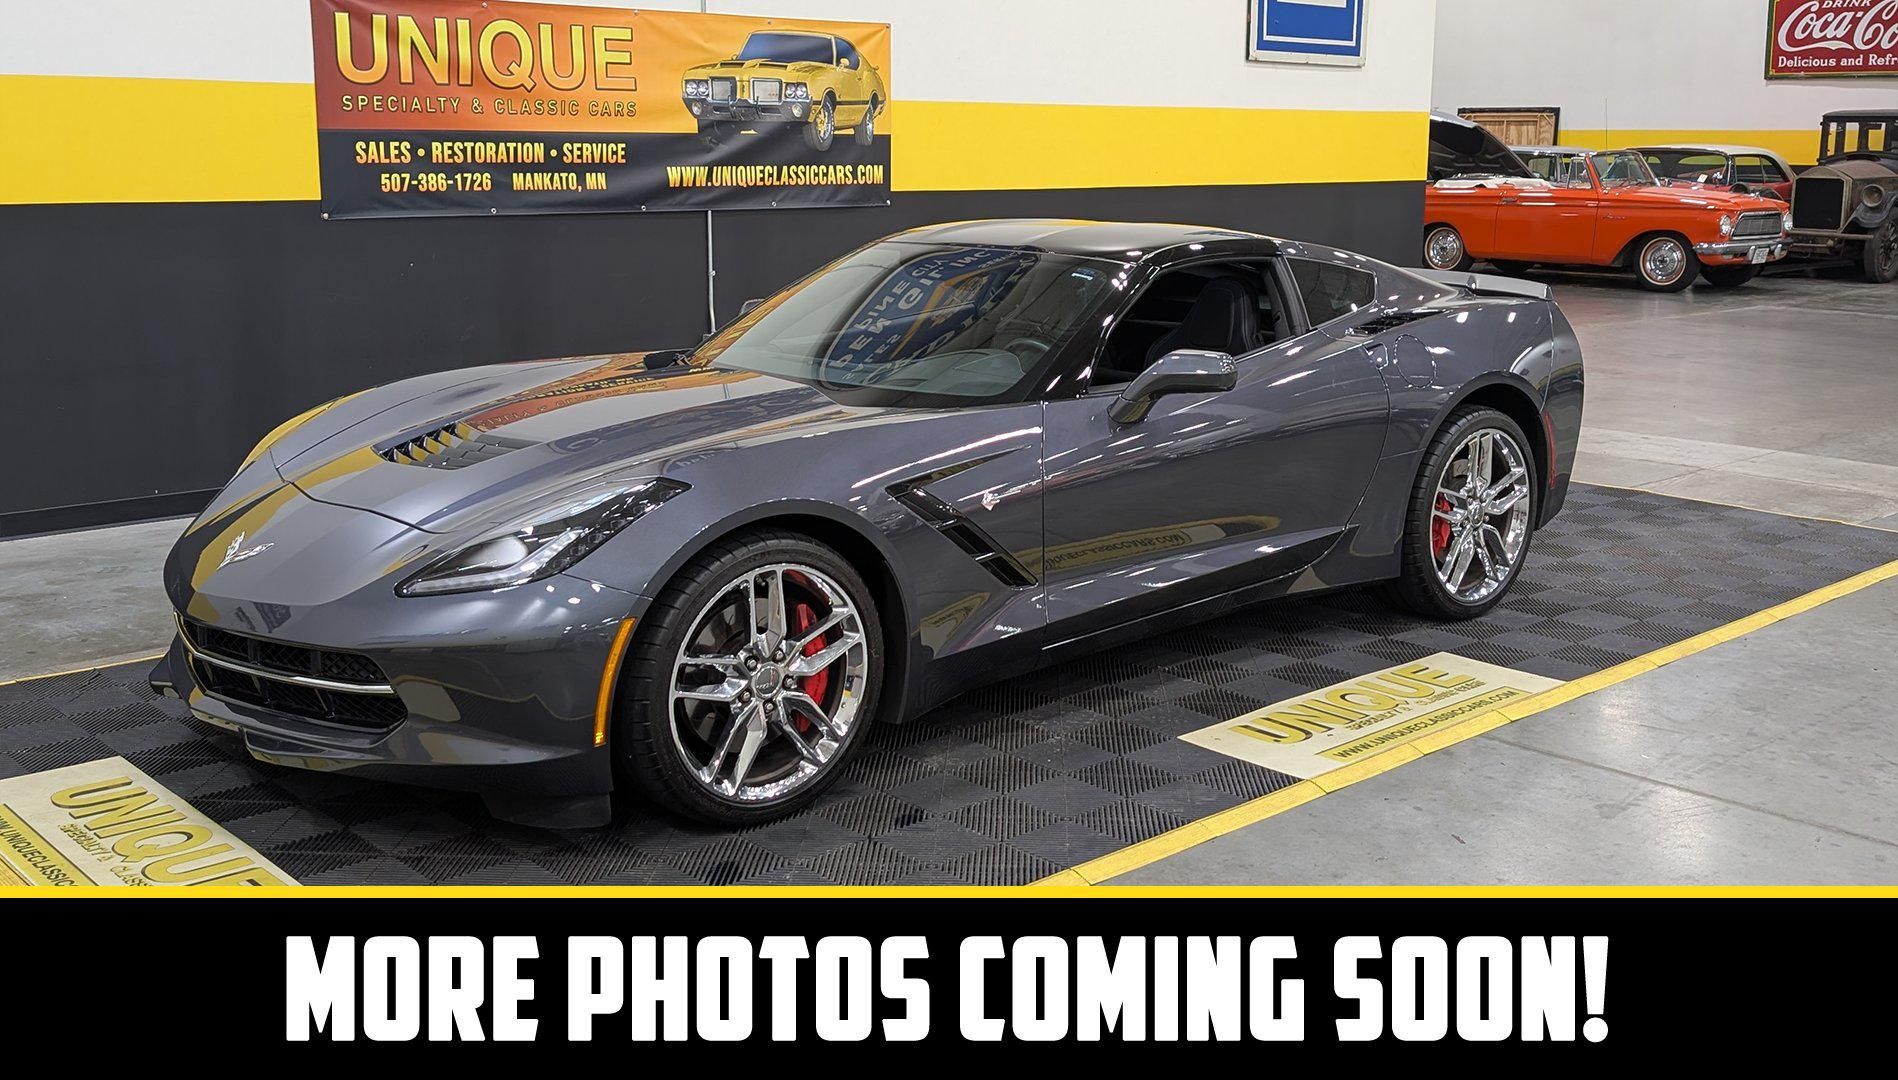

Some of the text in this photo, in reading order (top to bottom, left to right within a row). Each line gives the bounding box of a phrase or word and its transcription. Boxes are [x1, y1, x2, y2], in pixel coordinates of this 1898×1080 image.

[334, 11, 637, 93] UNIQUE
[1778, 55, 1836, 68] Delicious
[1840, 54, 1863, 66] and
[342, 95, 637, 117] SPECIALTY & CLASSIC CARS
[355, 141, 626, 164] SALES RESTORATION SERVICE
[380, 172, 492, 192] 507-386-1726
[512, 172, 607, 192] MANKATO, MN
[666, 164, 884, 188] WWW.UNIQUECLASSICCARS.COM
[1228, 664, 1476, 745] UNIQUE
